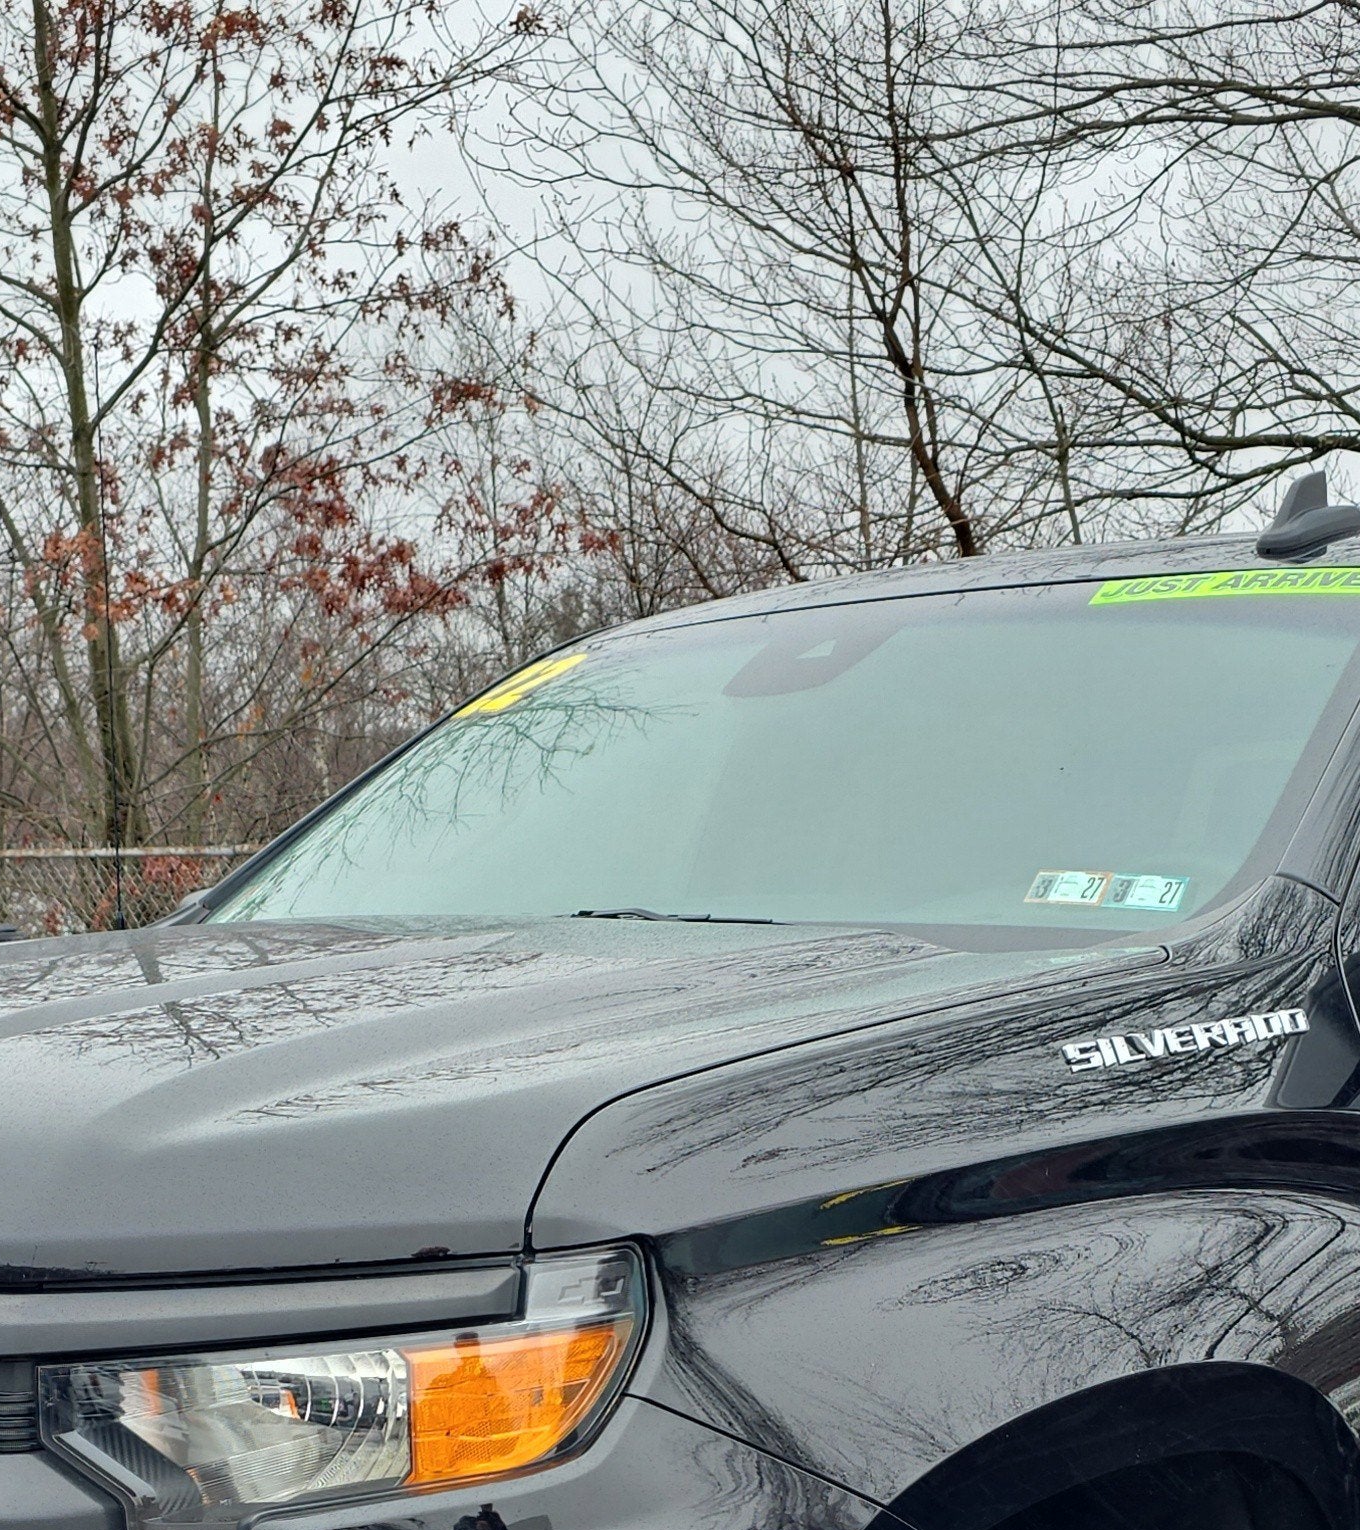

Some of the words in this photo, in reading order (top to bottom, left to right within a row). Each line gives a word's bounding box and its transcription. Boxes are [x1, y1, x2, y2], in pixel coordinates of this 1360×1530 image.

[1101, 575, 1211, 599] JUST
[1080, 876, 1106, 901] 27
[1158, 880, 1183, 904] 27
[1061, 1008, 1310, 1074] SILVERADO
